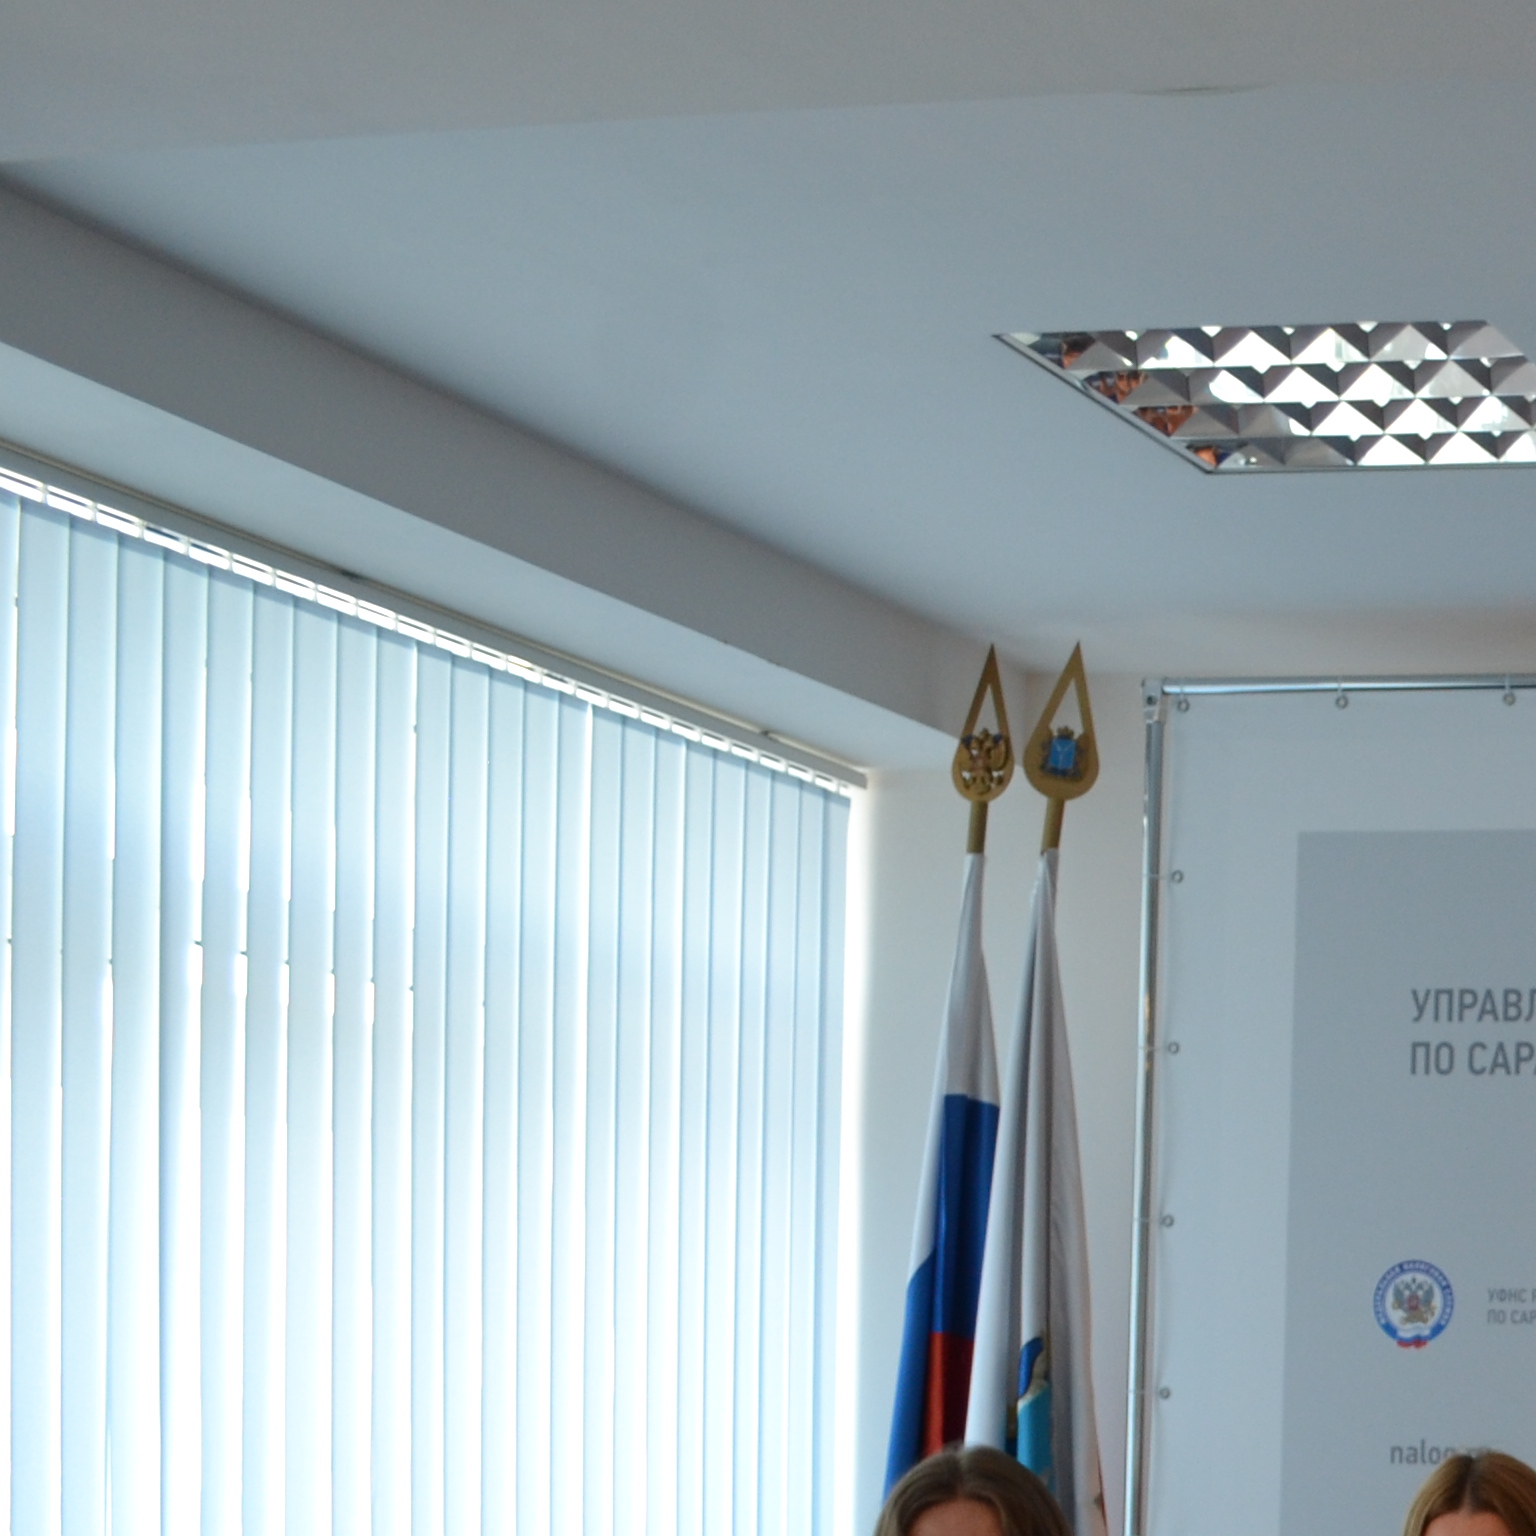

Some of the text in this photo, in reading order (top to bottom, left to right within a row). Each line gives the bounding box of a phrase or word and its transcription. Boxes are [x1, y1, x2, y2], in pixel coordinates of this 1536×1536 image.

[1410, 1041, 1455, 1076] ПО
[1488, 1288, 1527, 1303] УФНС
[1487, 1309, 1507, 1325] ПО
